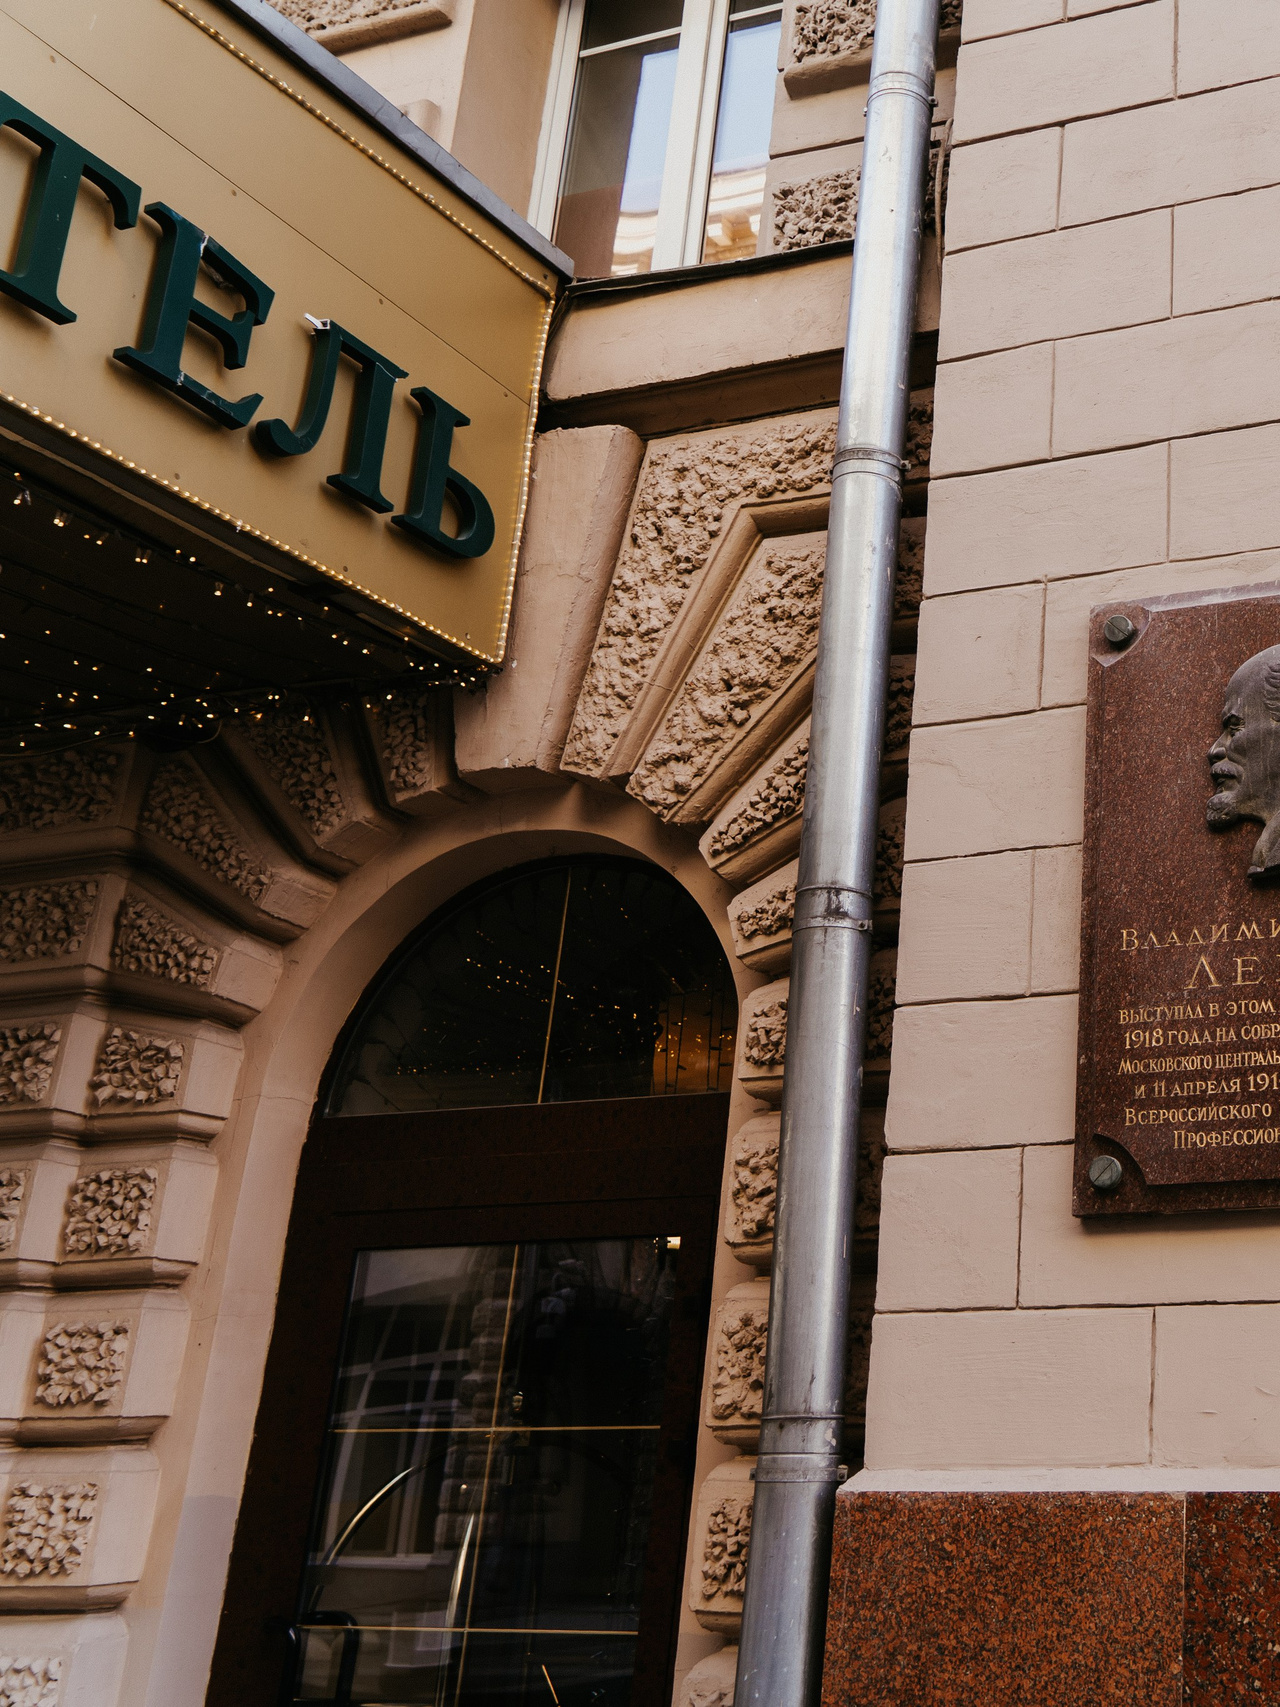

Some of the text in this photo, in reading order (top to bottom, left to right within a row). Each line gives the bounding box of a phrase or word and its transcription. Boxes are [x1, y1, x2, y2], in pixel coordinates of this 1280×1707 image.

[0, 90, 496, 559] ТЕЛЬ
[1118, 1003, 1204, 1025] ВЫСТУПАЛ
[1208, 1002, 1220, 1018] В
[1225, 999, 1276, 1016] ЭТОМ
[1124, 1028, 1164, 1049] 1918
[1167, 1029, 1213, 1046] ГОДА
[1216, 1027, 1238, 1043] НА
[1117, 1054, 1212, 1075] МОСКОВСКОГО
[1134, 1084, 1146, 1099] И
[1152, 1079, 1167, 1098] 11
[1170, 1078, 1241, 1097] АПРЕЛЯ
[1125, 1102, 1272, 1126] ВСЕРОССИЙСКОГО
